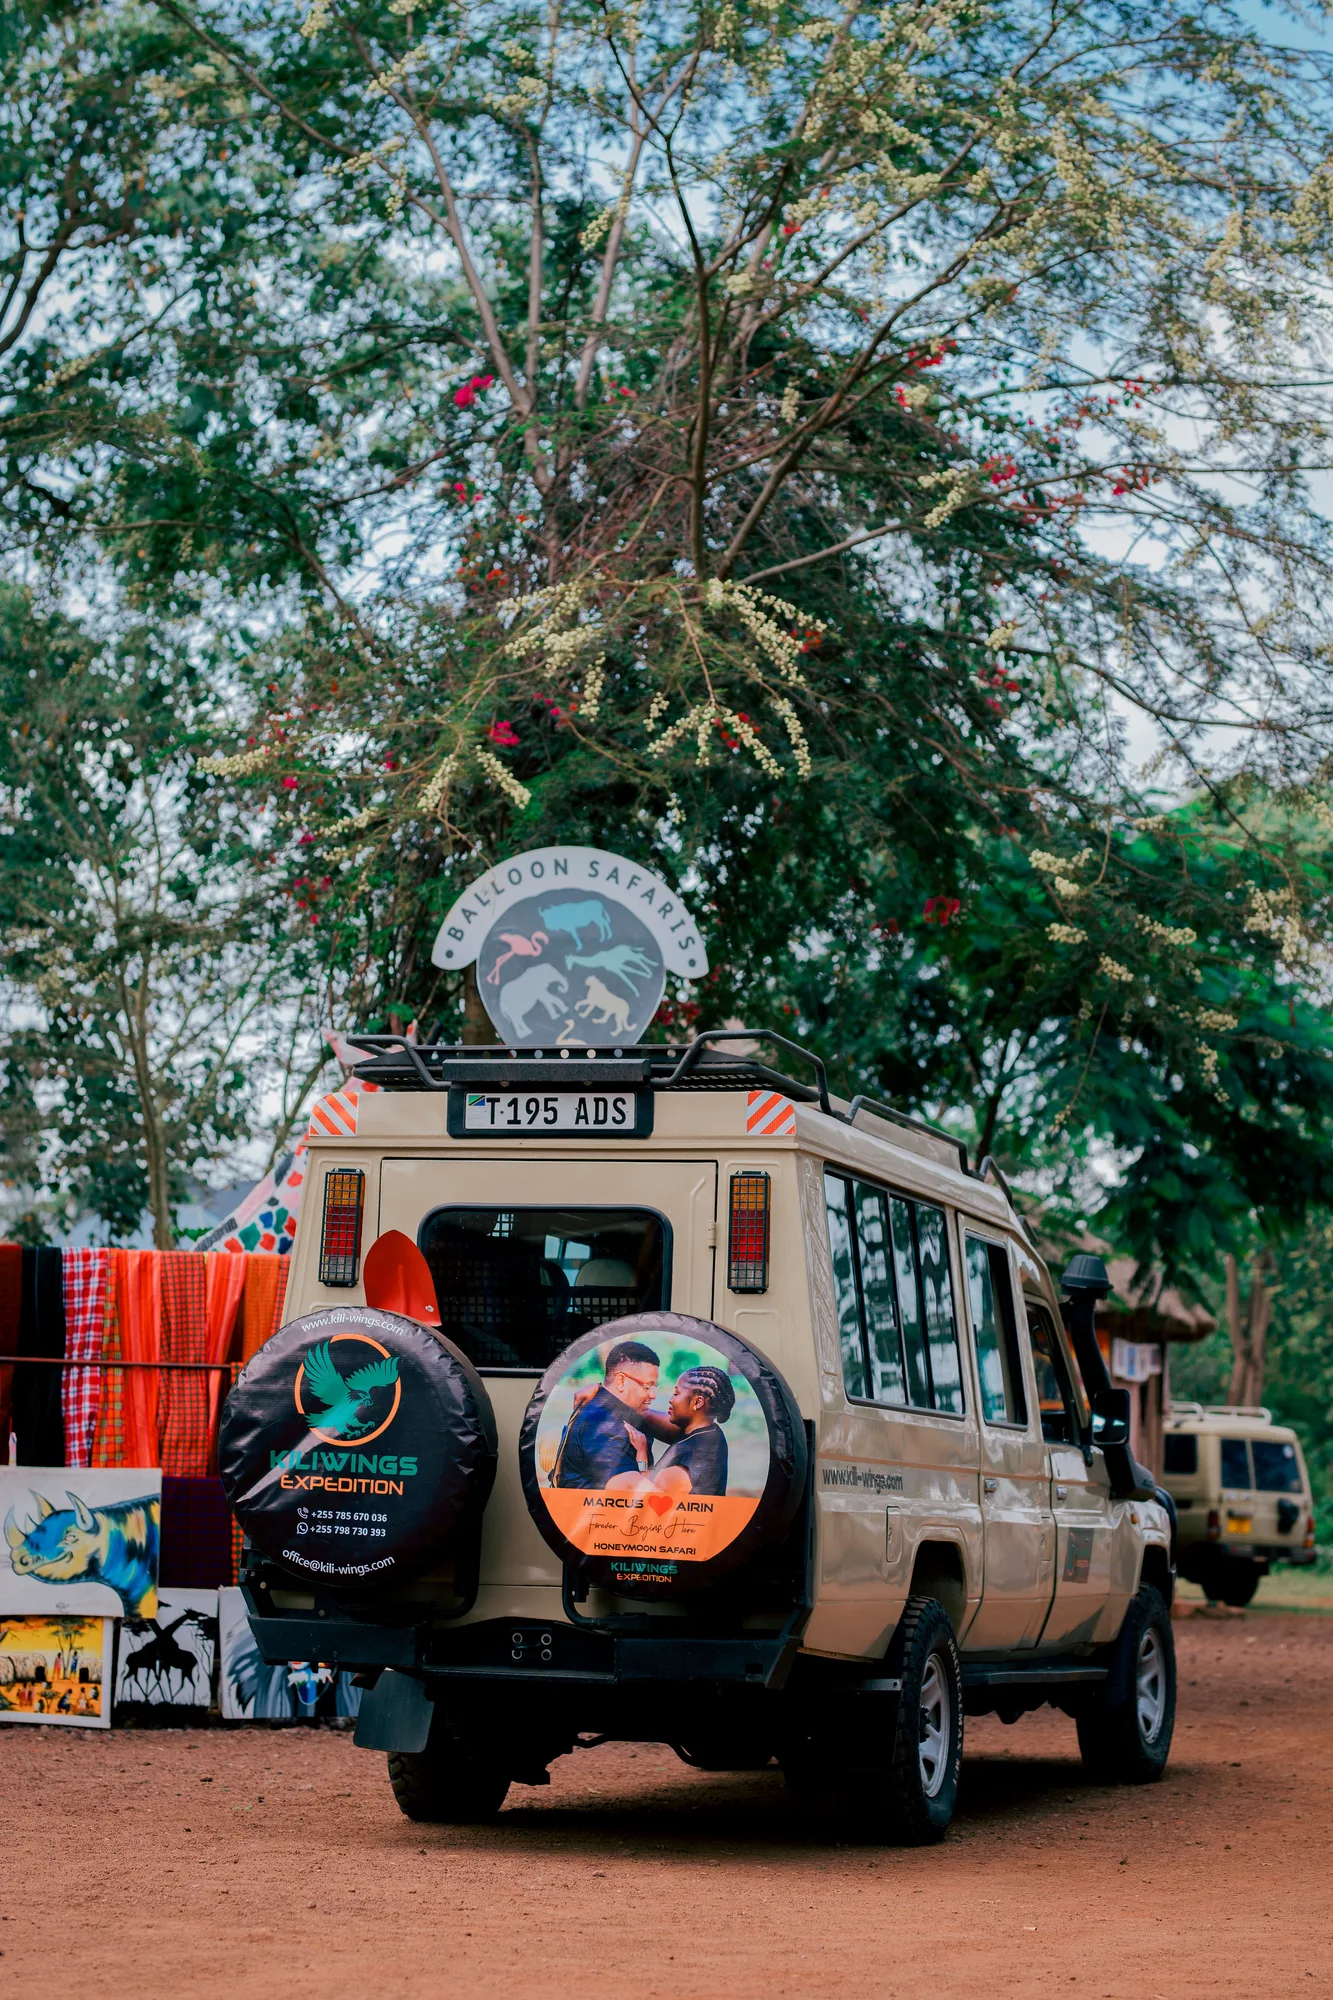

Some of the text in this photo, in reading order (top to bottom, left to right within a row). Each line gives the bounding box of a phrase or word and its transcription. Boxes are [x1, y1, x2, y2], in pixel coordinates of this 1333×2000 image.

[447, 858, 696, 951] BALLOON SAFARIS
[574, 1097, 627, 1125] ADS
[301, 1313, 405, 1336] www.kili-wings.com
[270, 1449, 418, 1476] KILIWINGS
[280, 1475, 404, 1496] EXPEDITION
[583, 1497, 714, 1513] MARCUS AIRIN
[311, 1510, 388, 1522] +255 785 670 036
[310, 1524, 386, 1537] +255 798 730 393
[587, 1513, 706, 1541] Forever Begins Here
[593, 1542, 696, 1555] HONEYMOON SAFARI
[282, 1548, 396, 1575] office@kili-wings.com
[610, 1561, 679, 1575] KILIWINGS
[616, 1573, 672, 1583] EXPEDITION
